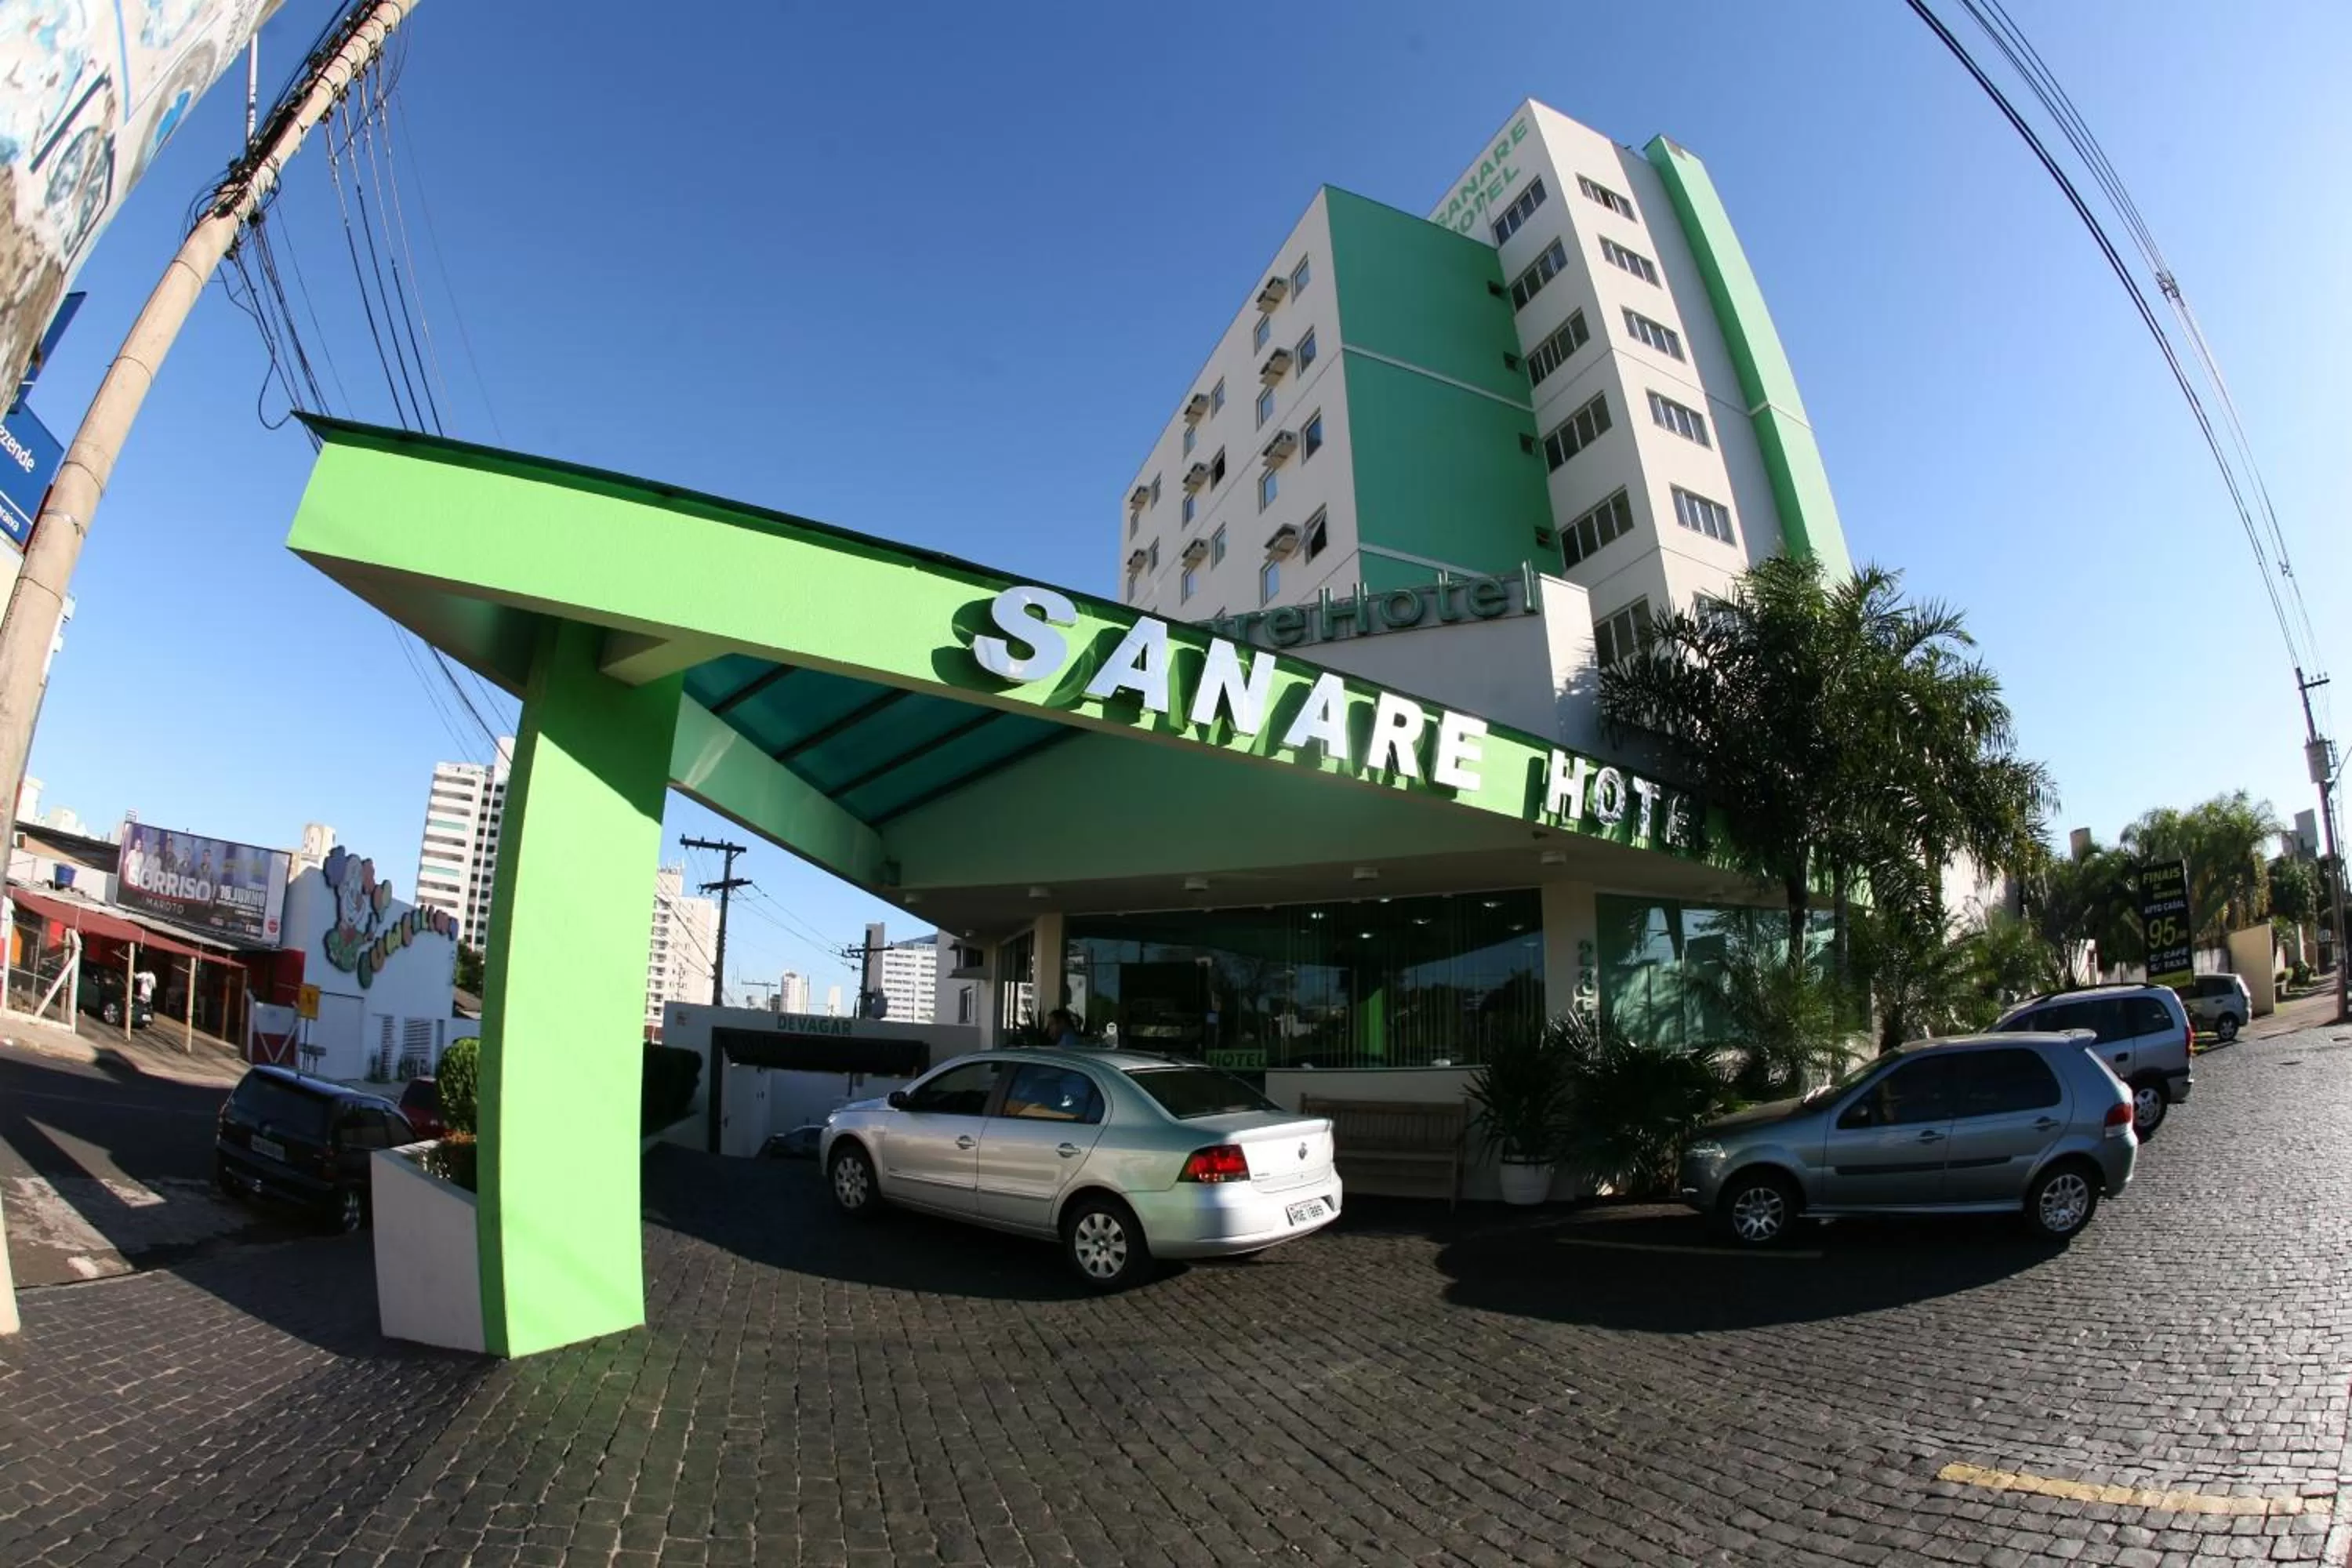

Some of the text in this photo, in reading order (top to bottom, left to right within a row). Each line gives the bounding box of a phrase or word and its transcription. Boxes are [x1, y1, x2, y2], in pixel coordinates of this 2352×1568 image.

[1453, 166, 1521, 233] OTEL
[974, 585, 1487, 792] SANARE
[128, 866, 212, 902] SORRISO
[145, 897, 185, 915] MAROTO
[777, 1015, 852, 1034] DEVAGAR
